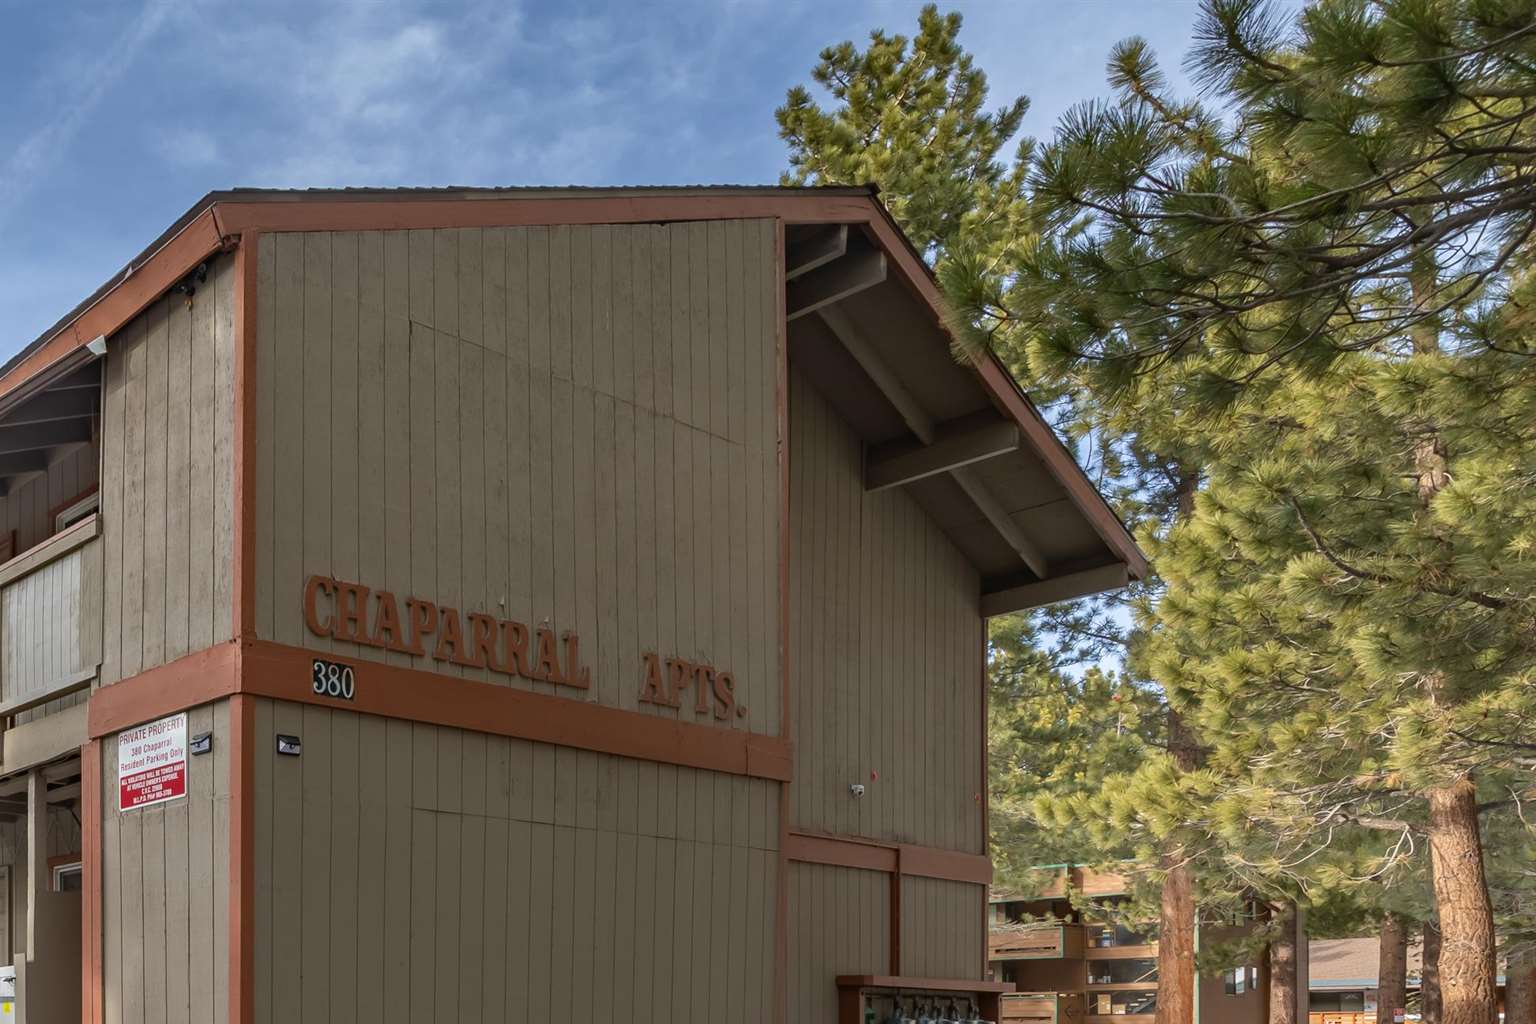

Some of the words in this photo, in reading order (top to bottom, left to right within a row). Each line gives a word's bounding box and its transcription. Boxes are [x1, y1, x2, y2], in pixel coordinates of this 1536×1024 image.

[303, 575, 591, 690] CHAPARRAL
[639, 651, 747, 720] APTS.
[313, 662, 354, 699] 380
[119, 729, 147, 746] PRIVATE
[148, 716, 185, 737] PROPERTY
[121, 759, 145, 772] Resident
[146, 752, 168, 765] Parking
[170, 748, 184, 758] Only
[131, 746, 142, 757] 380
[144, 737, 172, 753] Chaparral
